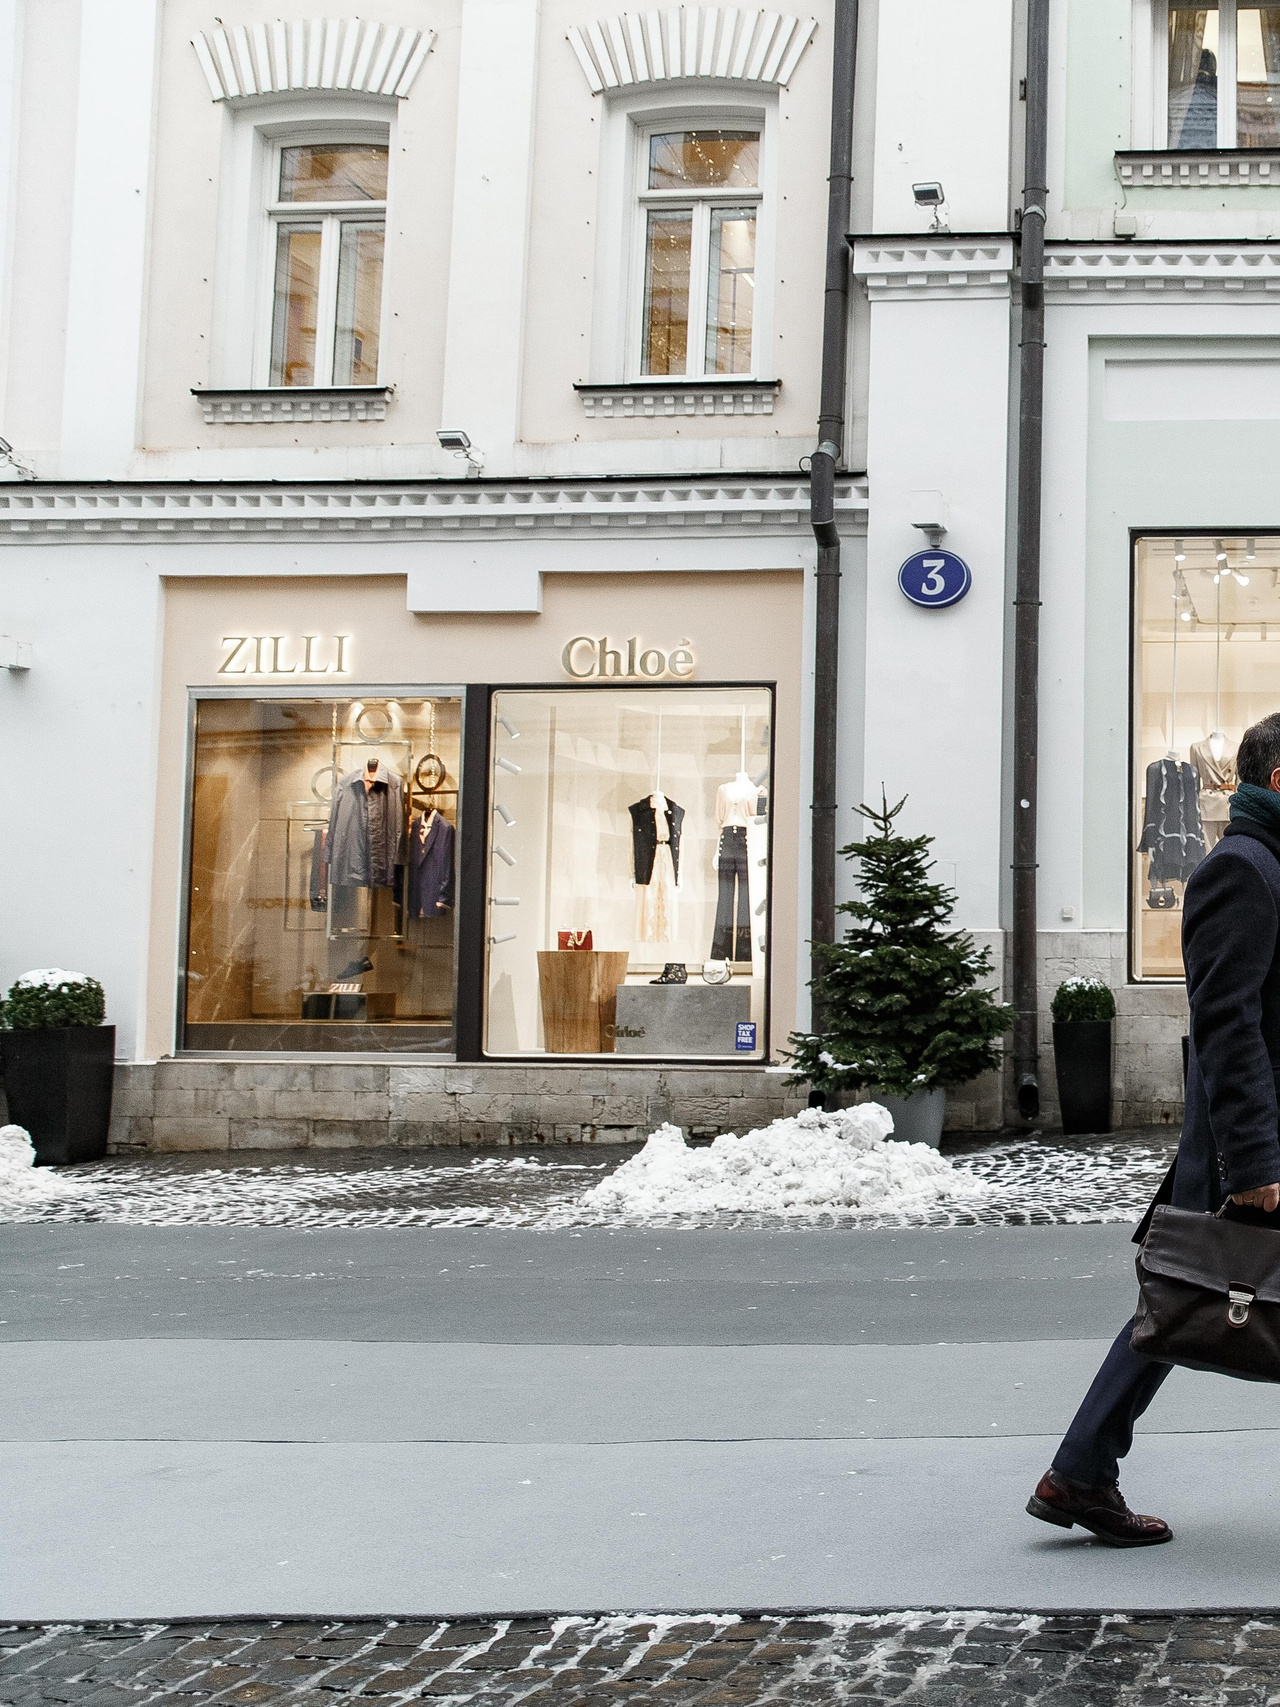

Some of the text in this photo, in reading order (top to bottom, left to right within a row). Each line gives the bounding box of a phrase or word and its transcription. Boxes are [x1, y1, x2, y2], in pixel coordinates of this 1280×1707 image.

[921, 559, 946, 596] 3
[217, 635, 350, 674] ZILLI
[561, 636, 694, 678] Chloé
